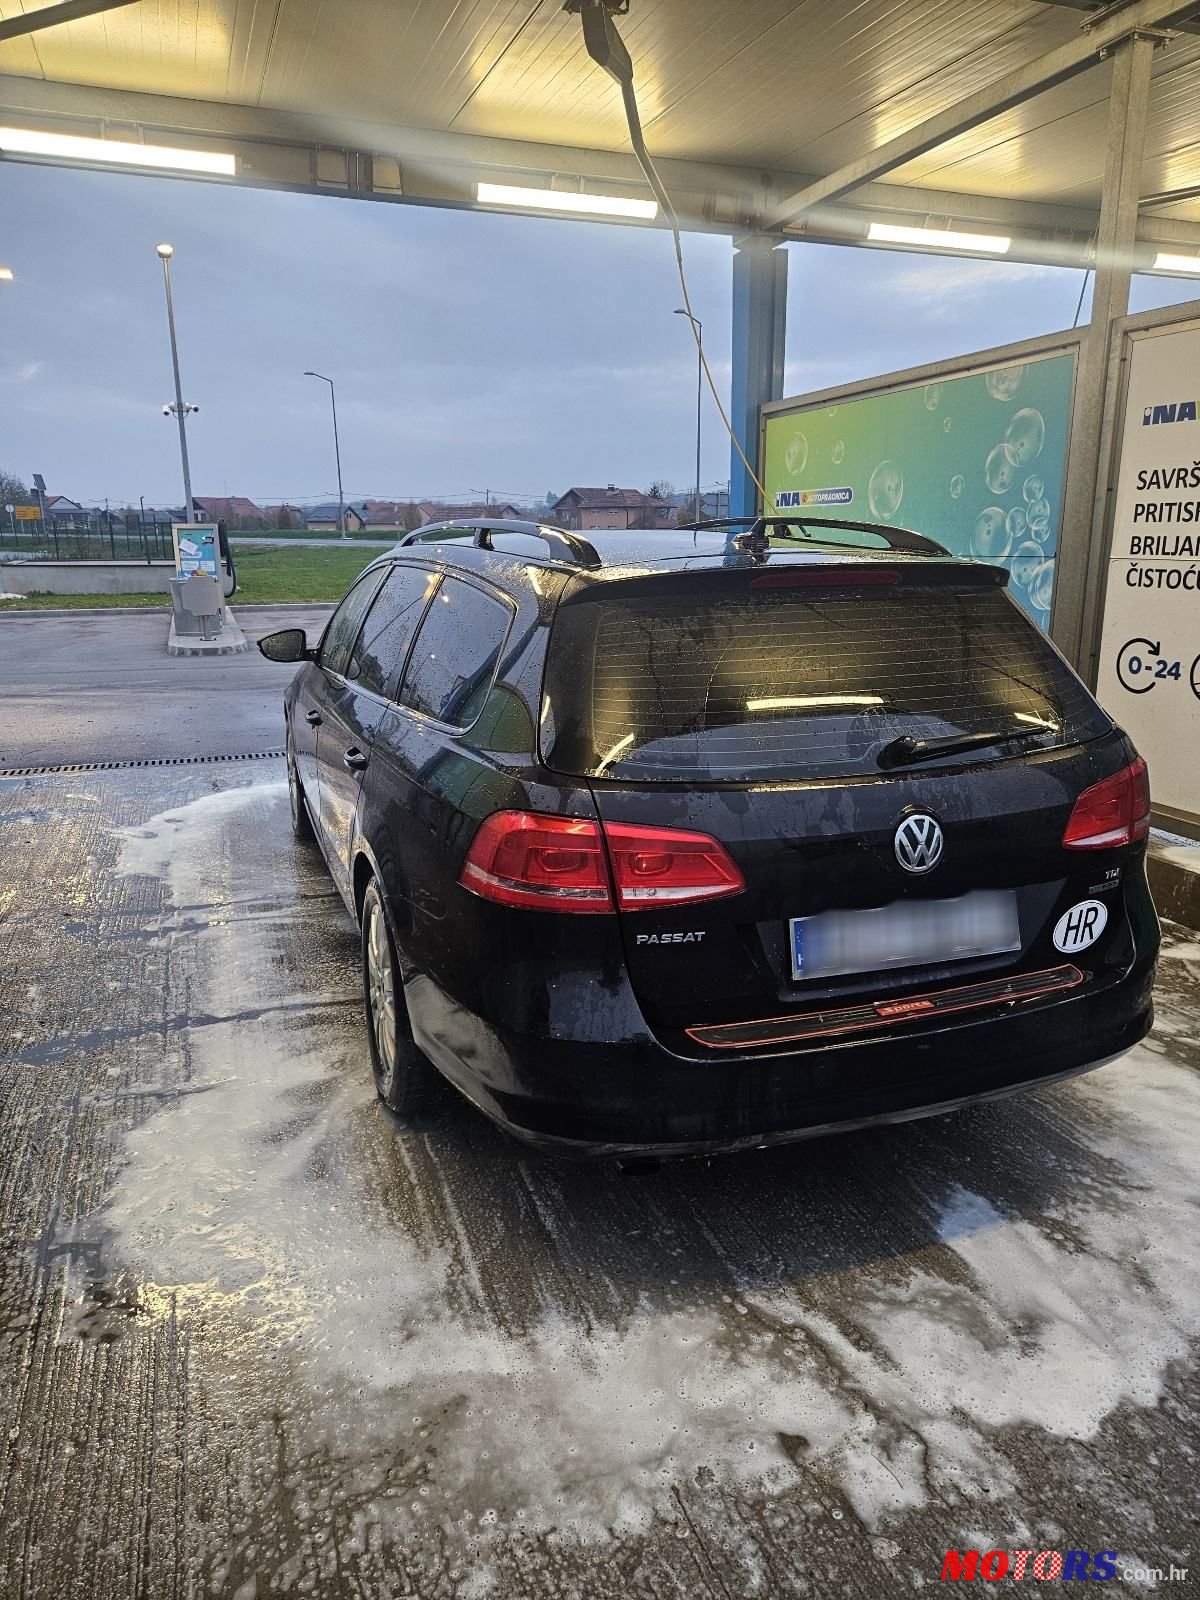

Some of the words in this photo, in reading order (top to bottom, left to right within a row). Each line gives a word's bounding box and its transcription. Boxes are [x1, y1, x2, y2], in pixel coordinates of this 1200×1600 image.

[1126, 562, 1200, 590] ČISTOĆ
[636, 931, 706, 945] PASSAT
[1062, 906, 1099, 947] HR
